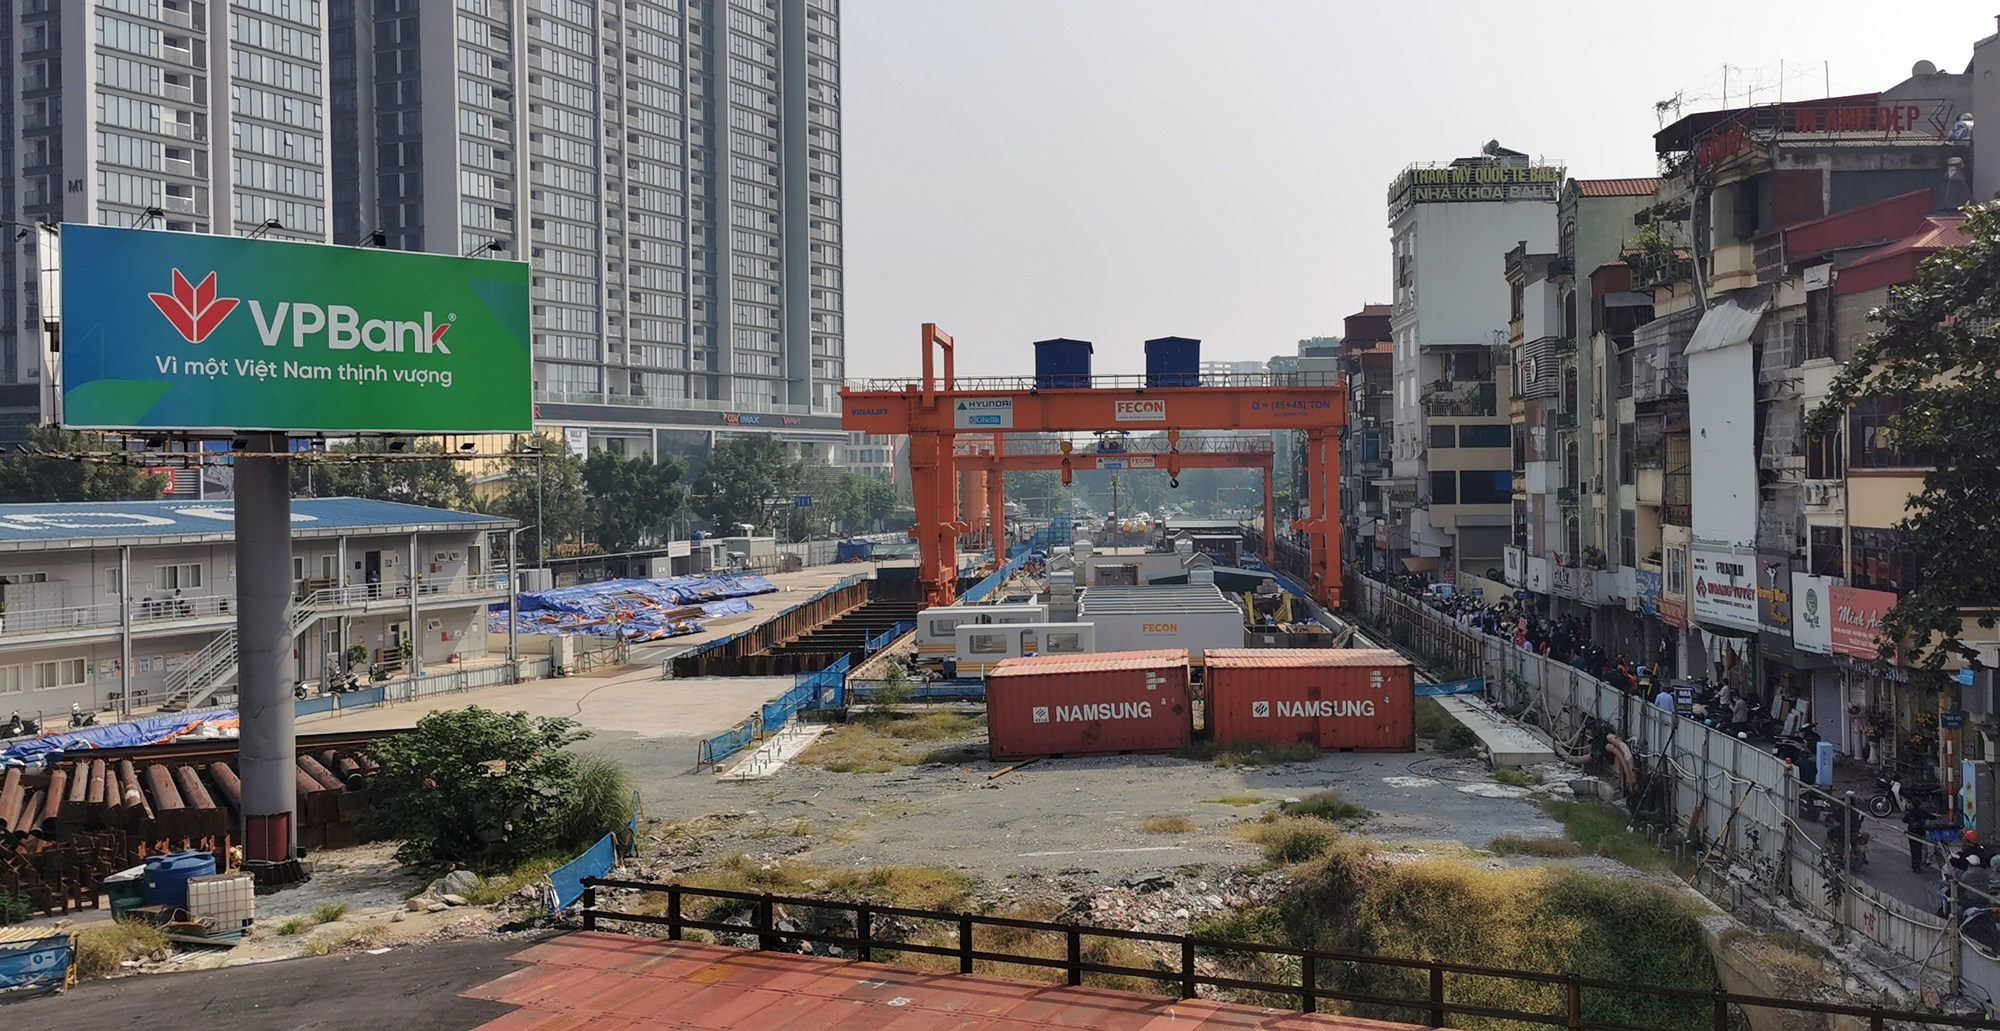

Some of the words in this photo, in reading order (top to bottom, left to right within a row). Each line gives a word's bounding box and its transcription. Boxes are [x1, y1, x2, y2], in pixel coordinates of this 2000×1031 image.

[1530, 166, 1567, 183] BALLY
[68, 178, 84, 194] M1
[1457, 186, 1504, 199] KHOA
[1509, 185, 1560, 199] BALLY
[248, 300, 452, 355] VPBank
[155, 355, 178, 375] Vì
[184, 358, 229, 381] một
[234, 358, 278, 382] Việt
[283, 361, 332, 380] Nam
[337, 363, 388, 386] thịnh
[393, 369, 453, 388] vượng
[968, 400, 1012, 408] HYUNDAI
[1117, 401, 1163, 413] FECON
[1251, 401, 1260, 411] Q
[1308, 400, 1331, 410] TON
[740, 415, 760, 424] IMAX
[851, 408, 889, 416] VINALIFT
[1838, 605, 1865, 627] Minh
[1142, 623, 1178, 632] FECON
[1055, 701, 1152, 723] NAMSUNG
[1276, 700, 1375, 718] NAMSUNG
